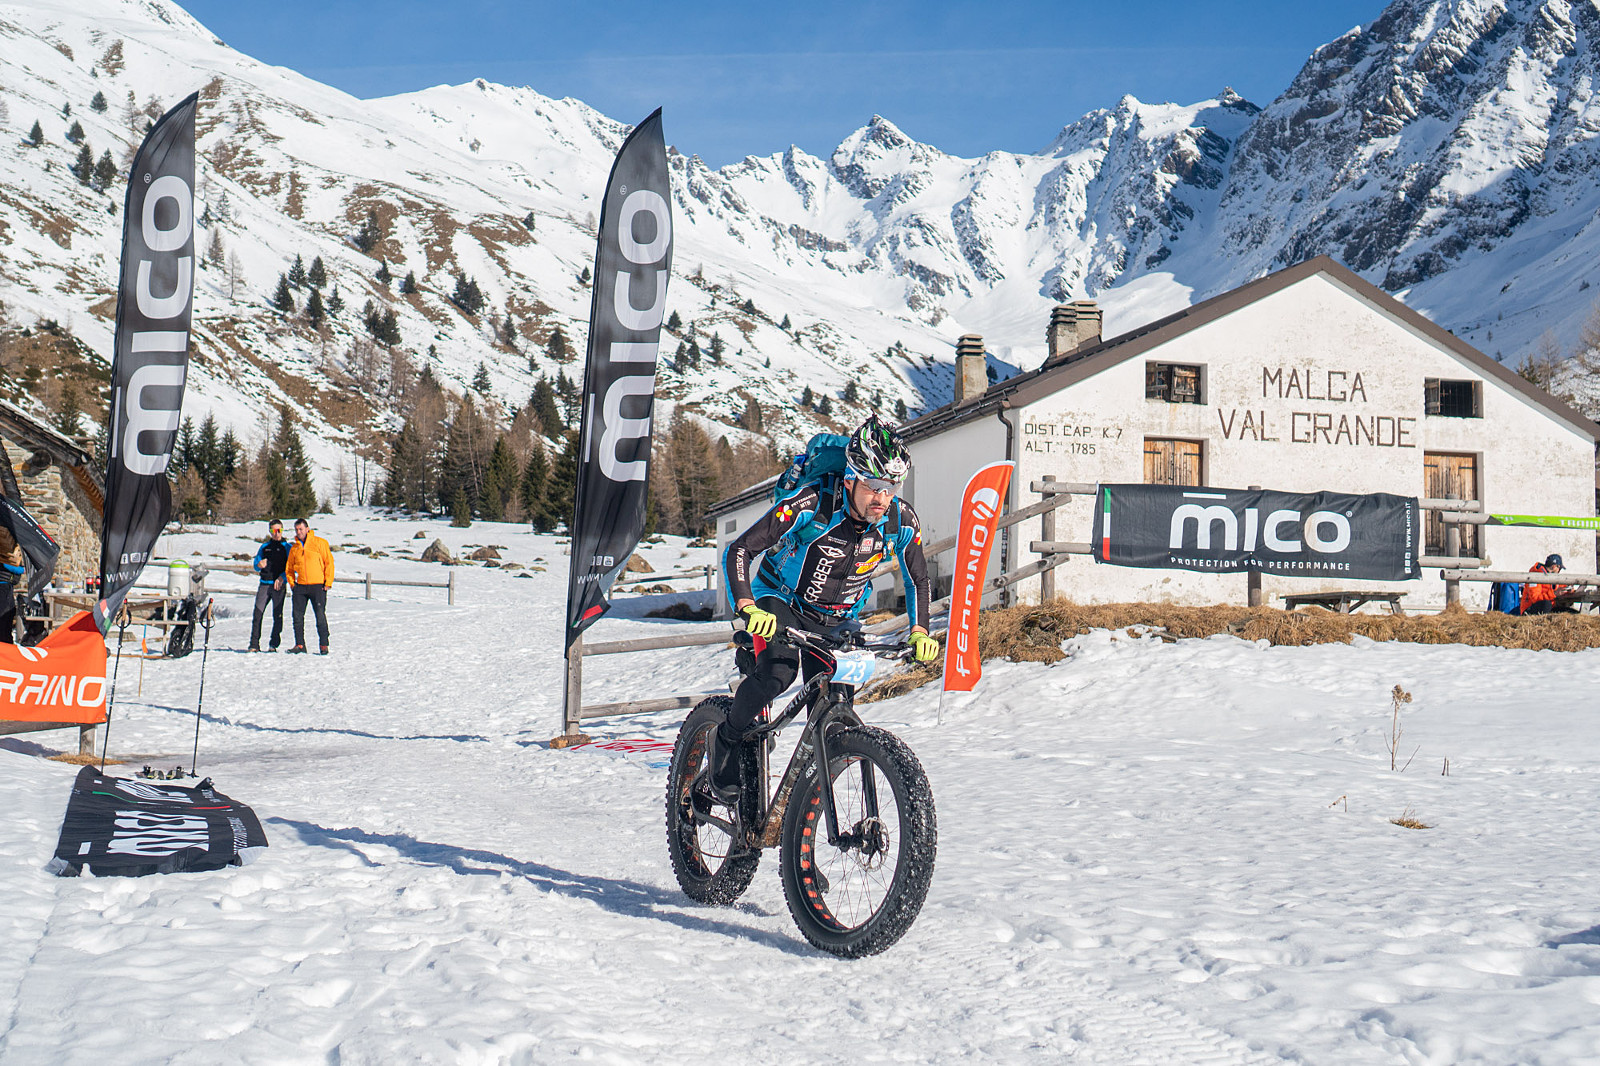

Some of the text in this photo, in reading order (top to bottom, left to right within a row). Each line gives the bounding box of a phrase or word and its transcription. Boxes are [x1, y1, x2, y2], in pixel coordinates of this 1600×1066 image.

[1262, 366, 1368, 403] MALGA
[1024, 422, 1060, 436] DIST.
[1063, 424, 1094, 438] CAP.
[1217, 408, 1417, 448] VAL GRANDE
[1025, 440, 1056, 453] ALT.
[1071, 442, 1097, 455] 1785
[1170, 556, 1351, 571] PROTECTION FOR PERFORMANCE
[803, 557, 836, 604] GRABER
[841, 660, 867, 682] 23
